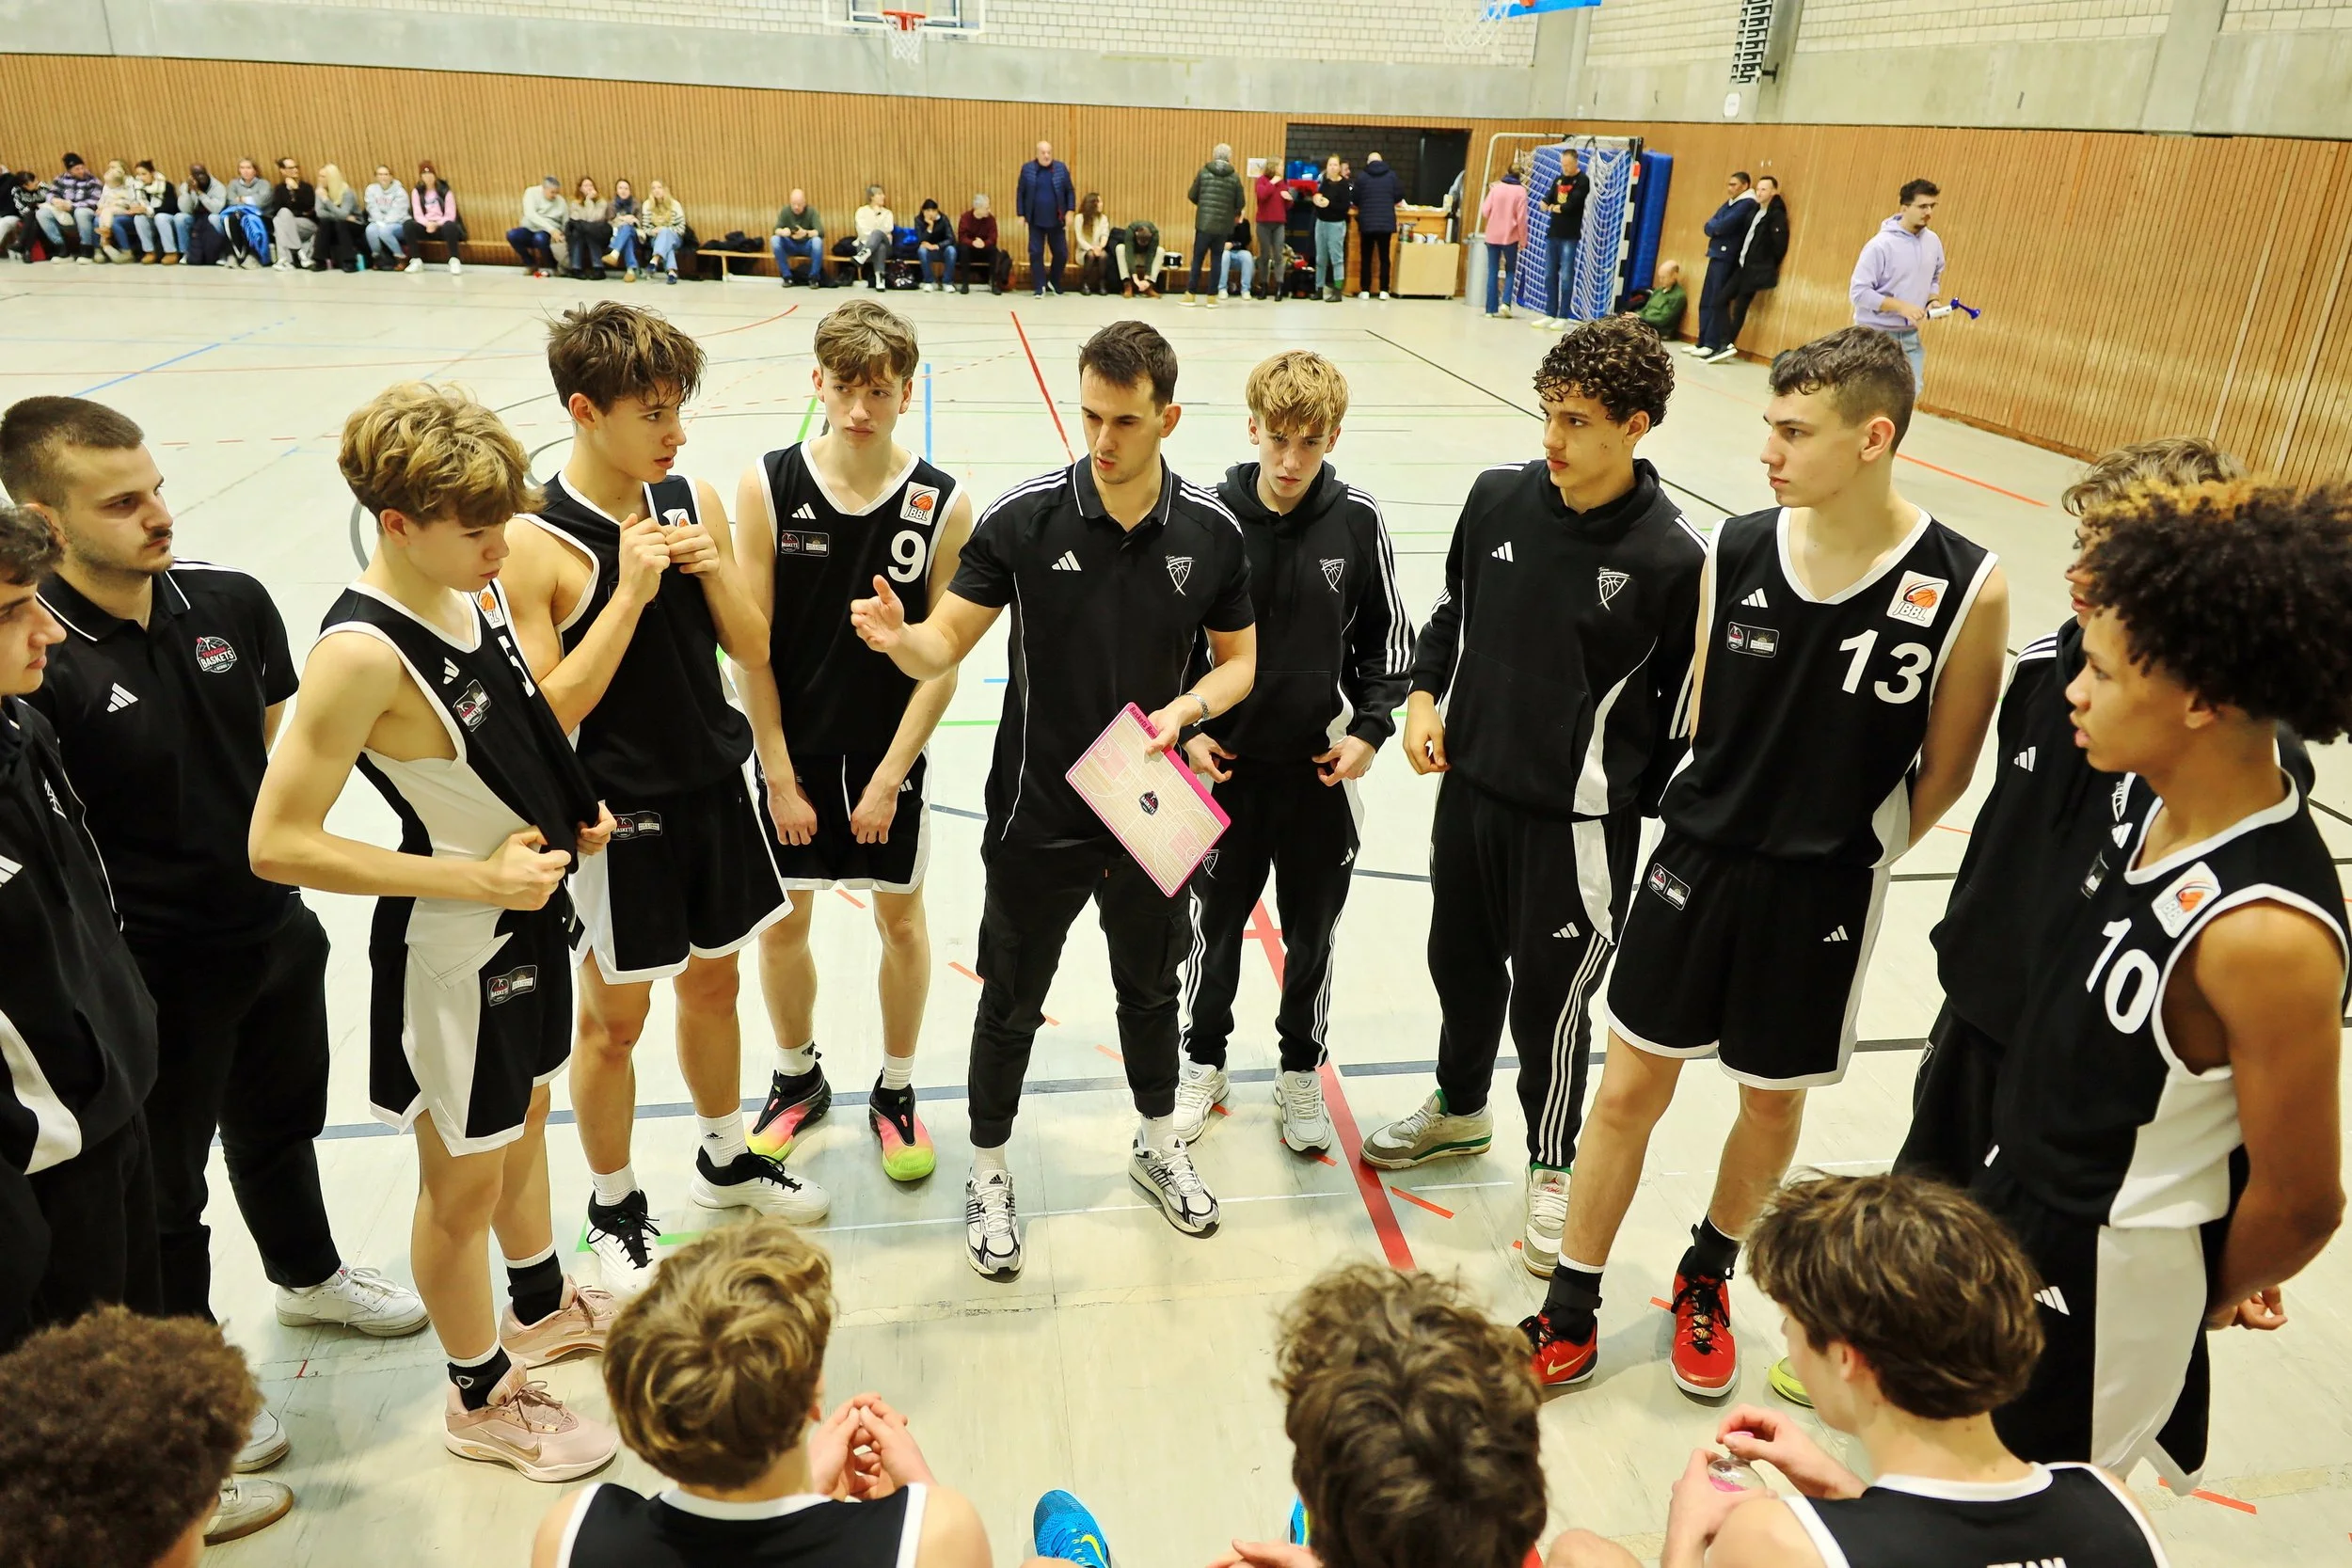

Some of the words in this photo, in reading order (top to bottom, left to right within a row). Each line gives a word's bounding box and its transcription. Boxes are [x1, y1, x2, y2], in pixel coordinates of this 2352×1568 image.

[904, 506, 929, 521] JBBL
[887, 530, 927, 583] 9
[1893, 601, 1927, 621] JBBL
[200, 650, 234, 669] BASKETS
[1838, 628, 1932, 705] 13
[1129, 706, 1148, 728] Baskets
[2085, 917, 2160, 1035] 10
